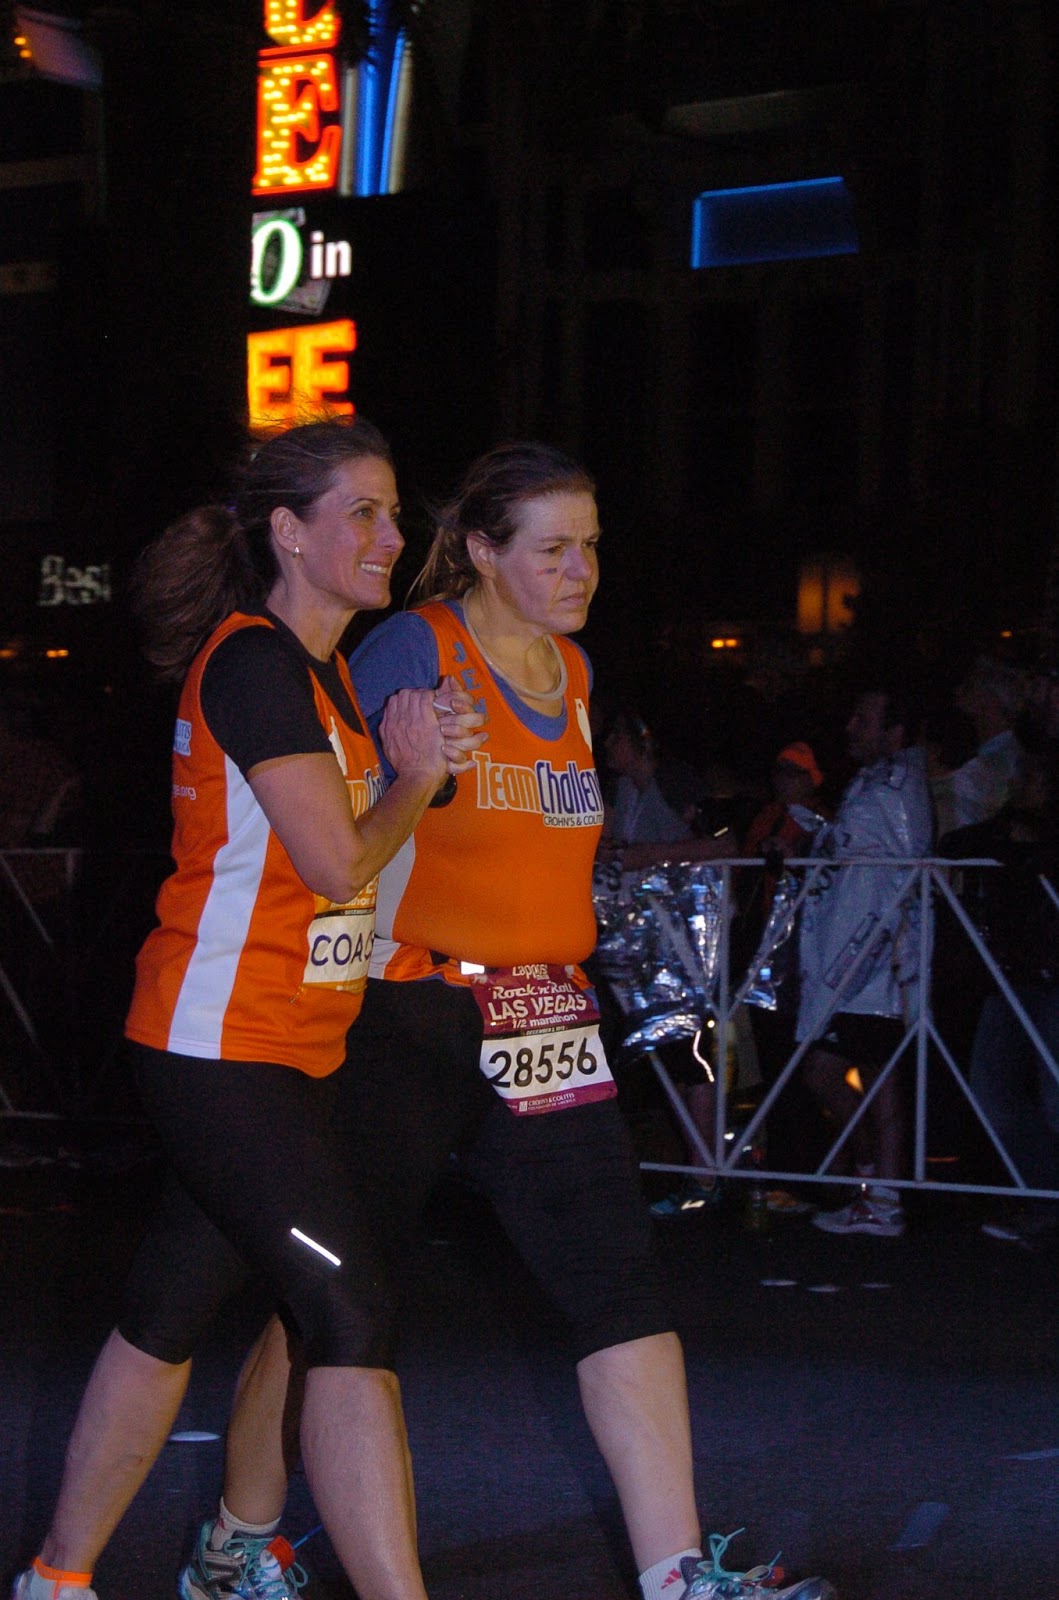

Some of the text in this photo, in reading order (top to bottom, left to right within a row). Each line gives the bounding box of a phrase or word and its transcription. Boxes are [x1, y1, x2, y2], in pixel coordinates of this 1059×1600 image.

[310, 231, 352, 279] in
[472, 751, 542, 814] Team
[544, 815, 575, 827] CROHN'S
[576, 816, 582, 826] &
[311, 929, 375, 966] COAC
[493, 984, 538, 1000] Rock
[547, 980, 575, 994] Roll
[487, 993, 588, 1021] LAS VEGAS
[512, 1012, 578, 1030] 1/2 marathon
[488, 1037, 598, 1088] 28556
